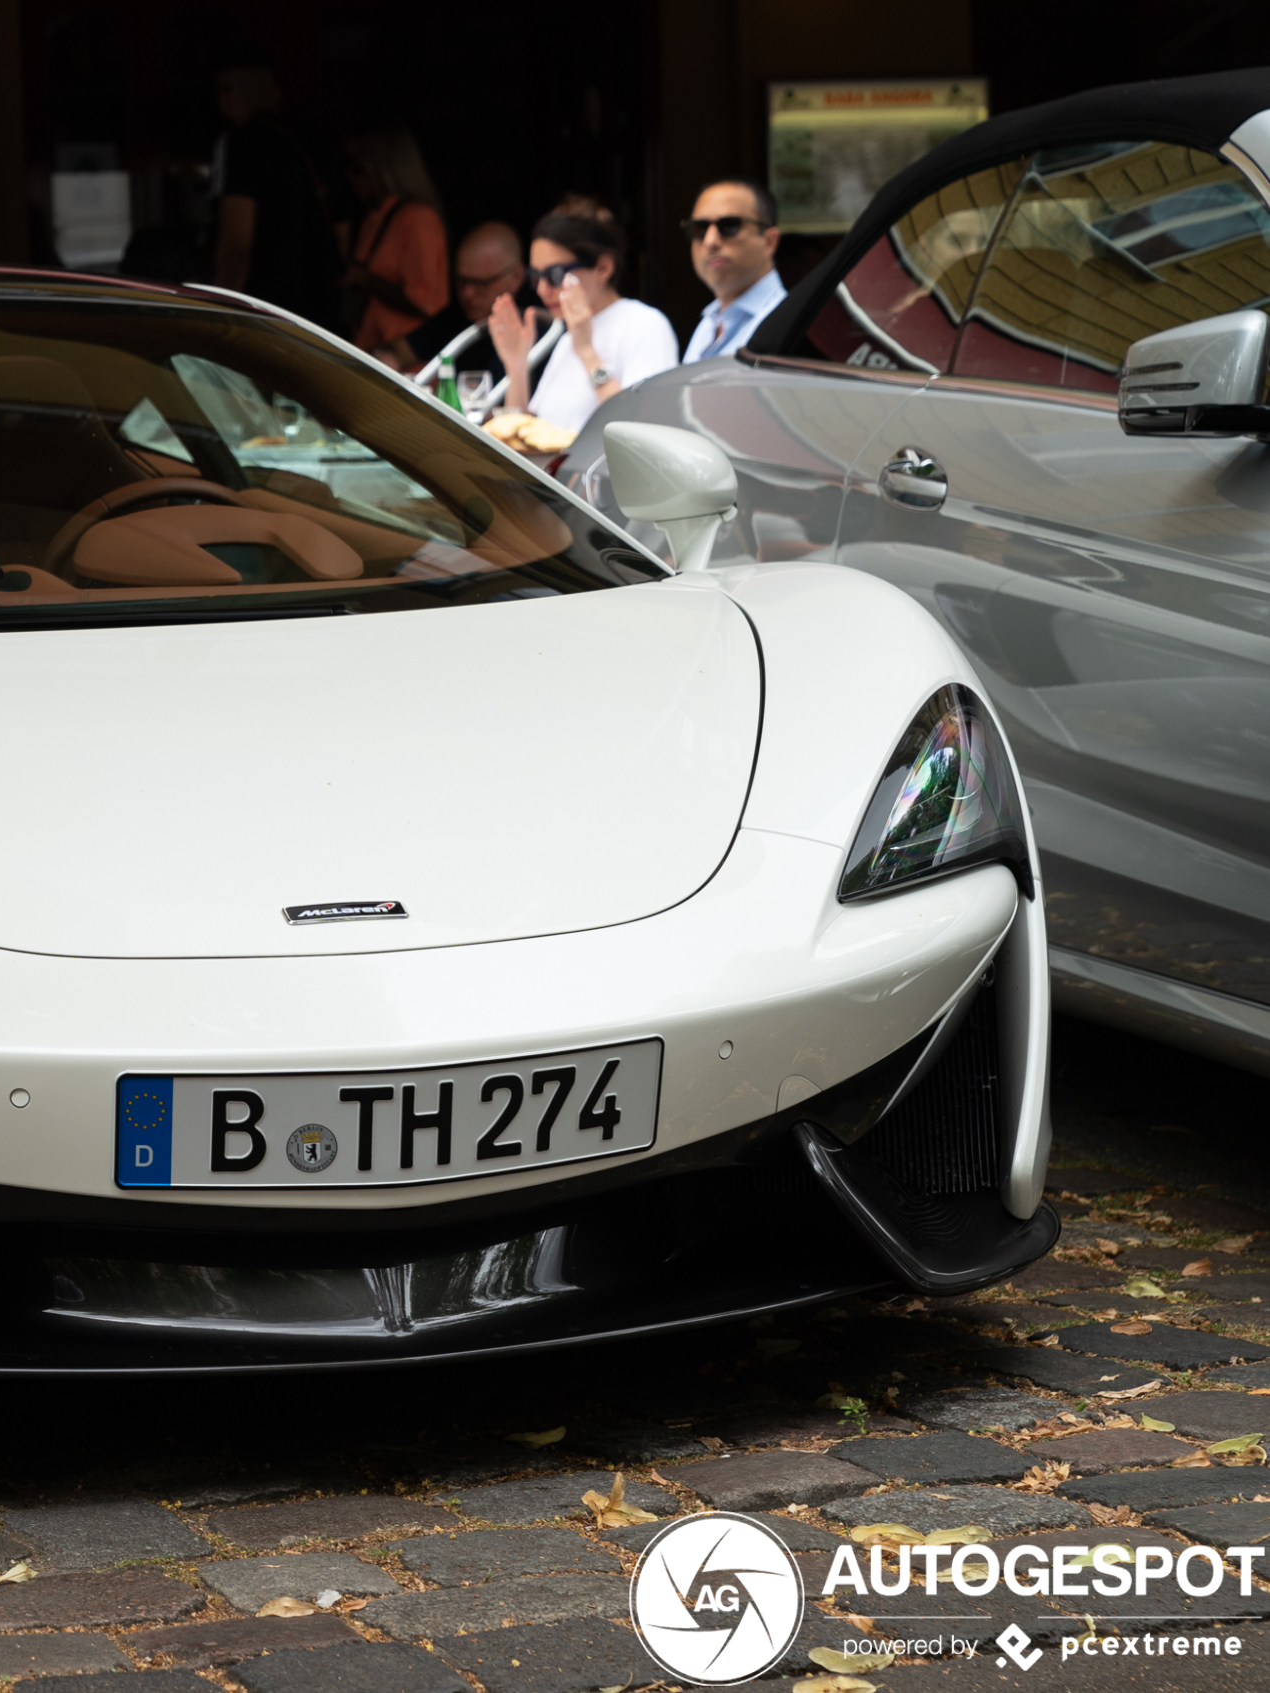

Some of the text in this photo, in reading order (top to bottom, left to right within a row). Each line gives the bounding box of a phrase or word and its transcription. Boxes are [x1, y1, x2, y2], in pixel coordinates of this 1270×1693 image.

[297, 906, 389, 917] McLaren
[210, 1058, 621, 1173] B TH 274
[298, 1125, 324, 1134] BERLIN
[135, 1144, 154, 1168] D
